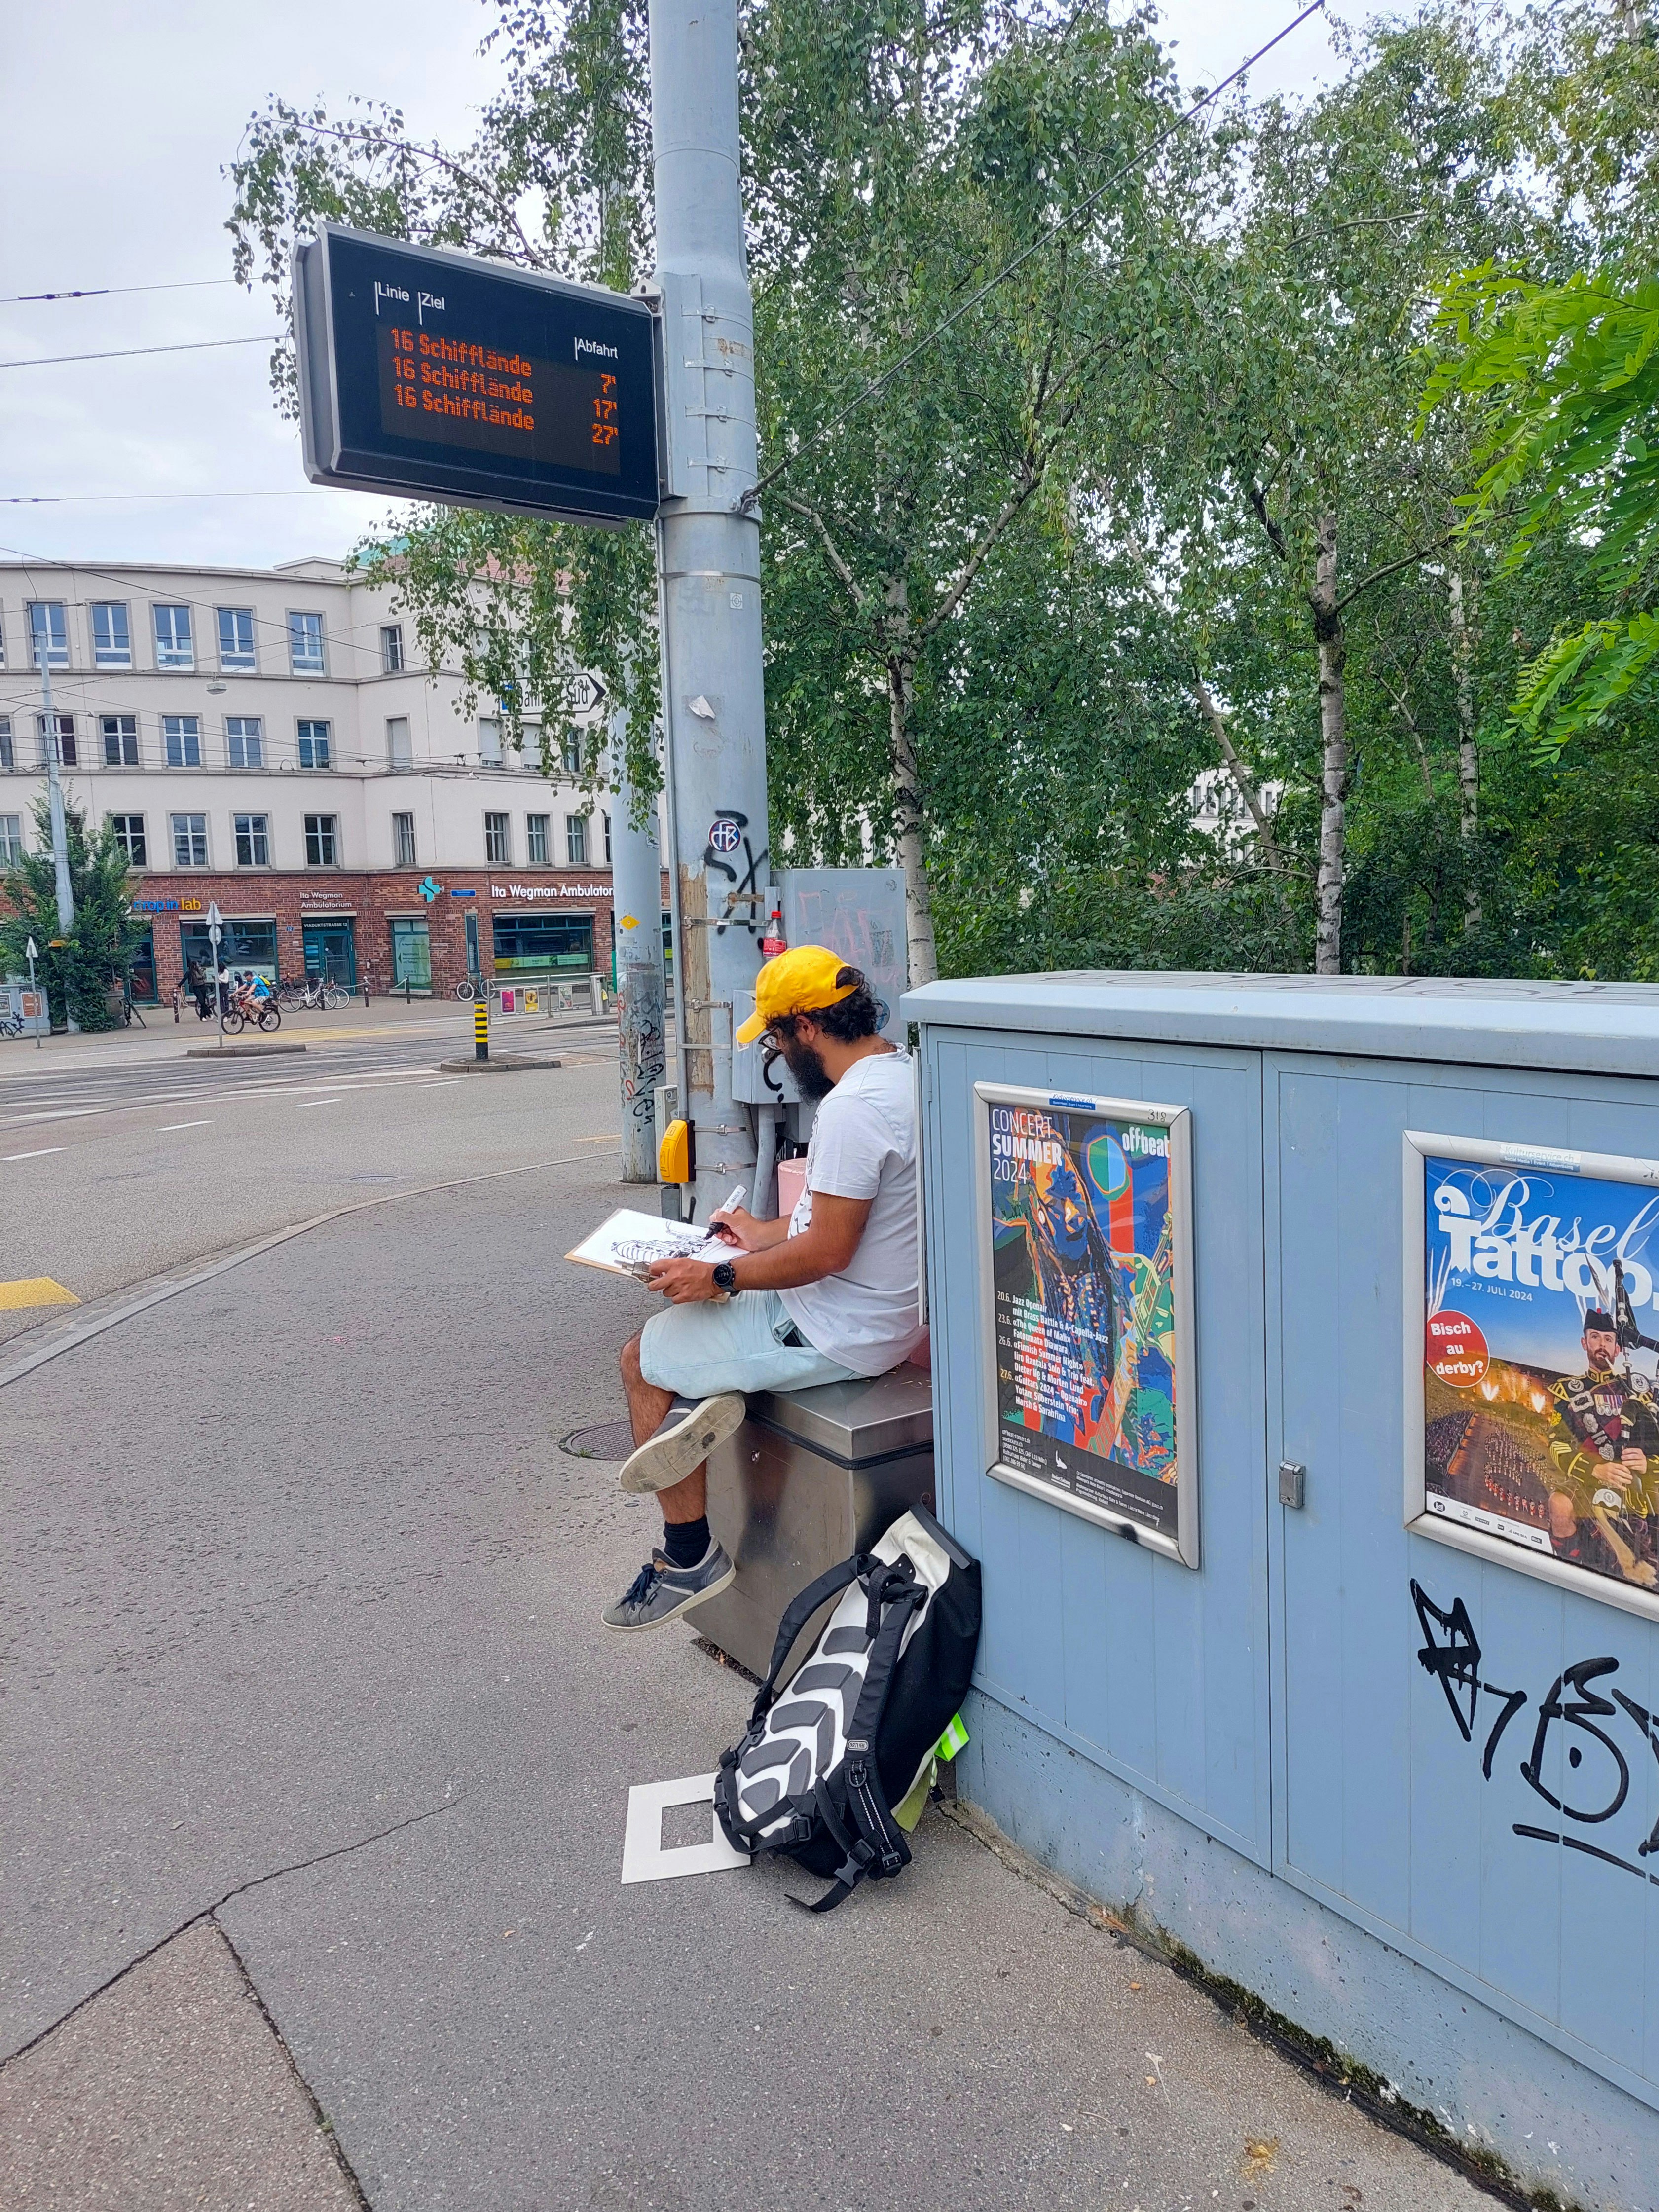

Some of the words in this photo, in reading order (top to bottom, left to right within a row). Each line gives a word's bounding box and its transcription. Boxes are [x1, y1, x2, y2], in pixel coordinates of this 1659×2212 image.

[378, 281, 409, 302] Linie
[421, 292, 445, 310] Ziel
[390, 328, 414, 352] 16
[419, 333, 532, 377] Schifflände
[600, 373, 616, 394] 7'
[578, 338, 618, 359] Abfahrt
[392, 356, 415, 380] 16
[420, 361, 533, 404] Schifflände
[592, 399, 617, 419] 17'
[394, 384, 417, 408] 16
[422, 389, 534, 430] Schifflände
[592, 423, 618, 445] 27'
[167, 898, 178, 910] in
[181, 897, 201, 911] lab
[491, 885, 506, 897] Ita
[509, 885, 557, 900] Wegman
[560, 884, 614, 897] Ambulator
[1053, 1093, 1092, 1104] Kulturservice.ch
[993, 1109, 1052, 1139] CONCERT
[1148, 1109, 1166, 1123] 318
[993, 1134, 1062, 1166] SUMMER
[1122, 1126, 1170, 1158] offbeat
[1505, 1145, 1574, 1163] Kulturservice.ch
[994, 1158, 1027, 1184] 2024
[1471, 1169, 1659, 1260] Basel
[1434, 1186, 1653, 1307] Tattoo
[997, 1291, 1011, 1303] 20.6.
[1012, 1295, 1025, 1306] Jazz
[1026, 1299, 1047, 1312] Openair
[1487, 1285, 1506, 1296] JULI
[1509, 1289, 1533, 1302] 2024
[998, 1313, 1012, 1325] 23.6.
[1013, 1318, 1027, 1329] «The
[1028, 1322, 1045, 1335] Queen
[1046, 1328, 1052, 1337] of
[1054, 1330, 1071, 1343] Mali»
[1012, 1307, 1023, 1317] mit
[1024, 1309, 1039, 1322] Brass
[1040, 1314, 1058, 1328] Battle
[1059, 1320, 1064, 1330] &
[1065, 1322, 1109, 1344] A-Capella-Jazz
[1431, 1321, 1471, 1336] Bisch
[998, 1335, 1012, 1348] 26.6.
[1013, 1341, 1038, 1356] «Finnish
[1038, 1348, 1061, 1364] Summer
[1063, 1356, 1083, 1370] Night»
[1013, 1328, 1043, 1346] Fatoumata
[1044, 1337, 1068, 1354] Diawara
[1446, 1344, 1464, 1355] au
[1014, 1362, 1032, 1376] Dieter
[1041, 1371, 1046, 1381] &
[1047, 1373, 1069, 1389] Morten
[1069, 1381, 1084, 1395] Lund
[1025, 1354, 1047, 1370] Rantala
[1048, 1362, 1060, 1375] Solo
[1061, 1367, 1066, 1377] &
[1067, 1368, 1079, 1381] Trio
[1080, 1373, 1095, 1387] feat.
[1436, 1360, 1484, 1376] derby?
[1000, 1368, 1014, 1381] 27.6.
[1015, 1375, 1039, 1390] «Guitars
[1040, 1382, 1054, 1396] 2024
[1061, 1390, 1087, 1407] Openair»
[1015, 1384, 1033, 1399] Yotam
[1034, 1391, 1064, 1410] Silberstein
[1015, 1396, 1032, 1409] Harsh
[1033, 1402, 1037, 1411] &
[1038, 1404, 1066, 1422] Sarahfina
